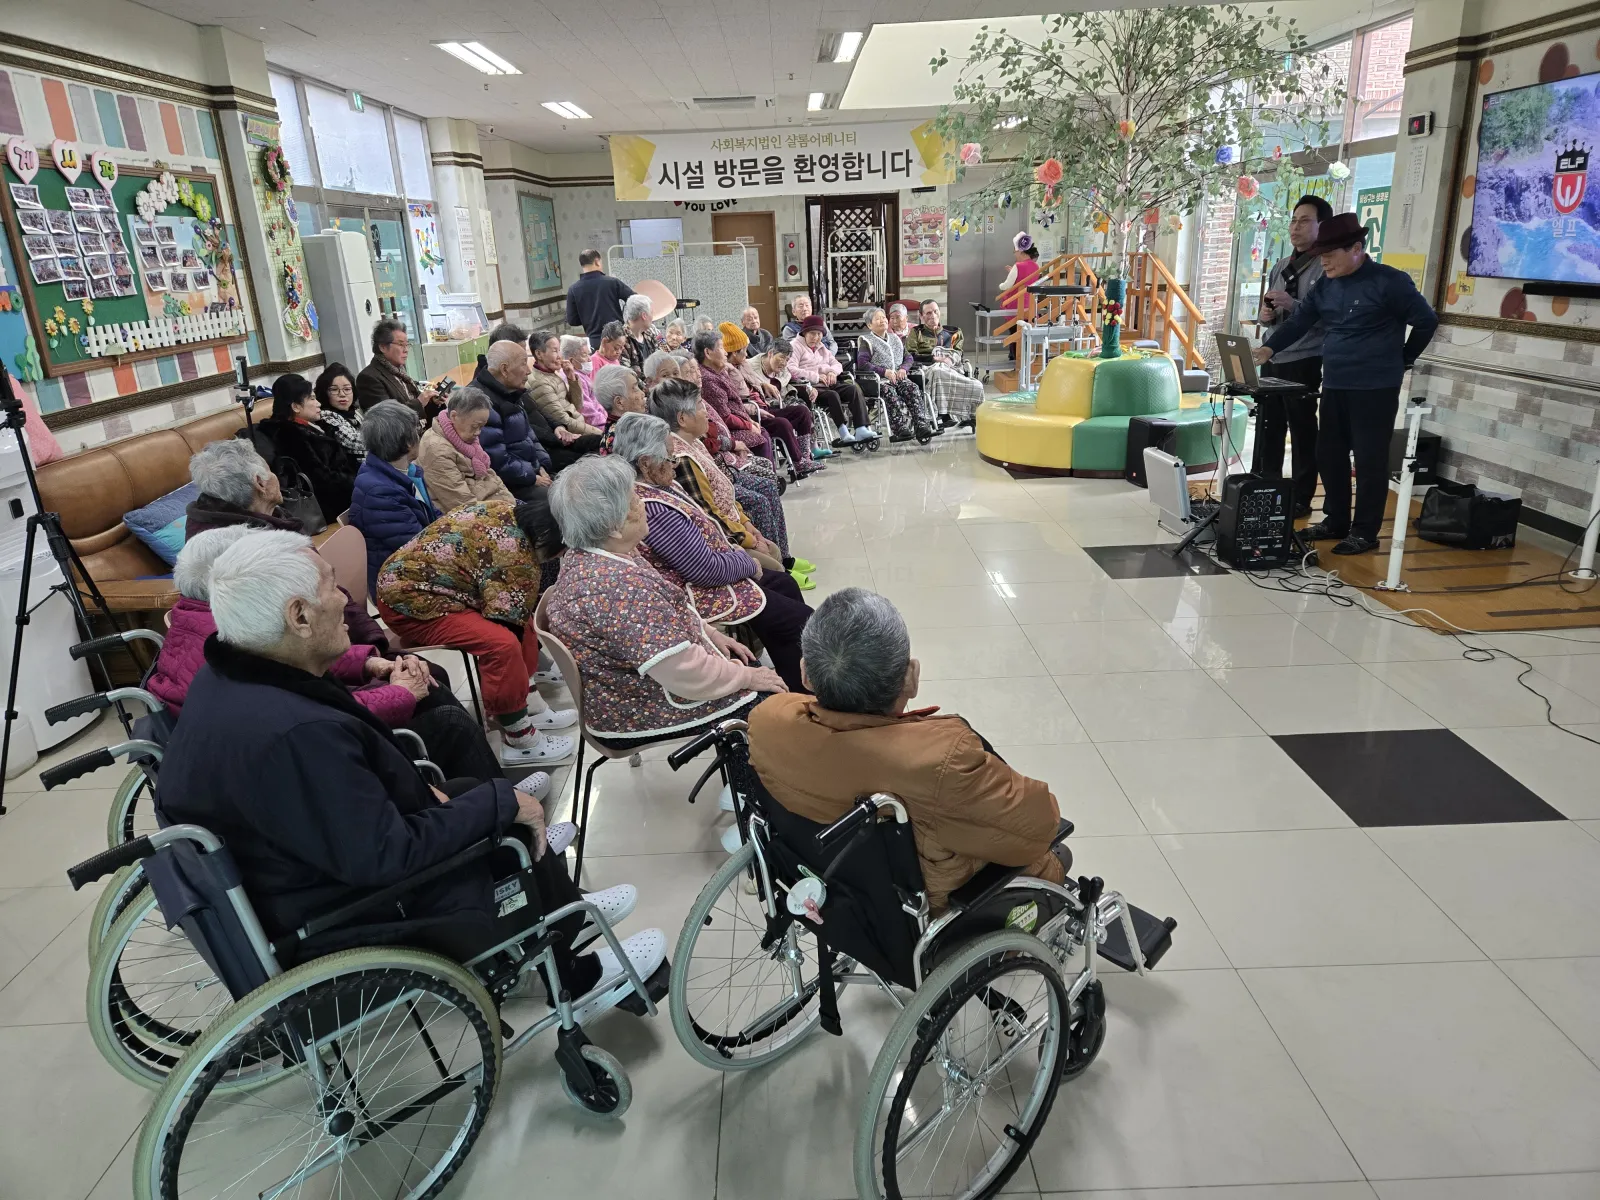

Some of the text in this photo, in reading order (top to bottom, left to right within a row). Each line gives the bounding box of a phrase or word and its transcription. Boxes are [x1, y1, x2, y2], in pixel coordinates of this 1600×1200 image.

[710, 131, 857, 153] 사회복지법인 샬롬어메니티
[657, 149, 913, 190] 시설 방문을 환영합니다
[1559, 156, 1585, 169] ELF
[684, 198, 738, 212] YOU LOVE
[1552, 218, 1577, 238] 엘프
